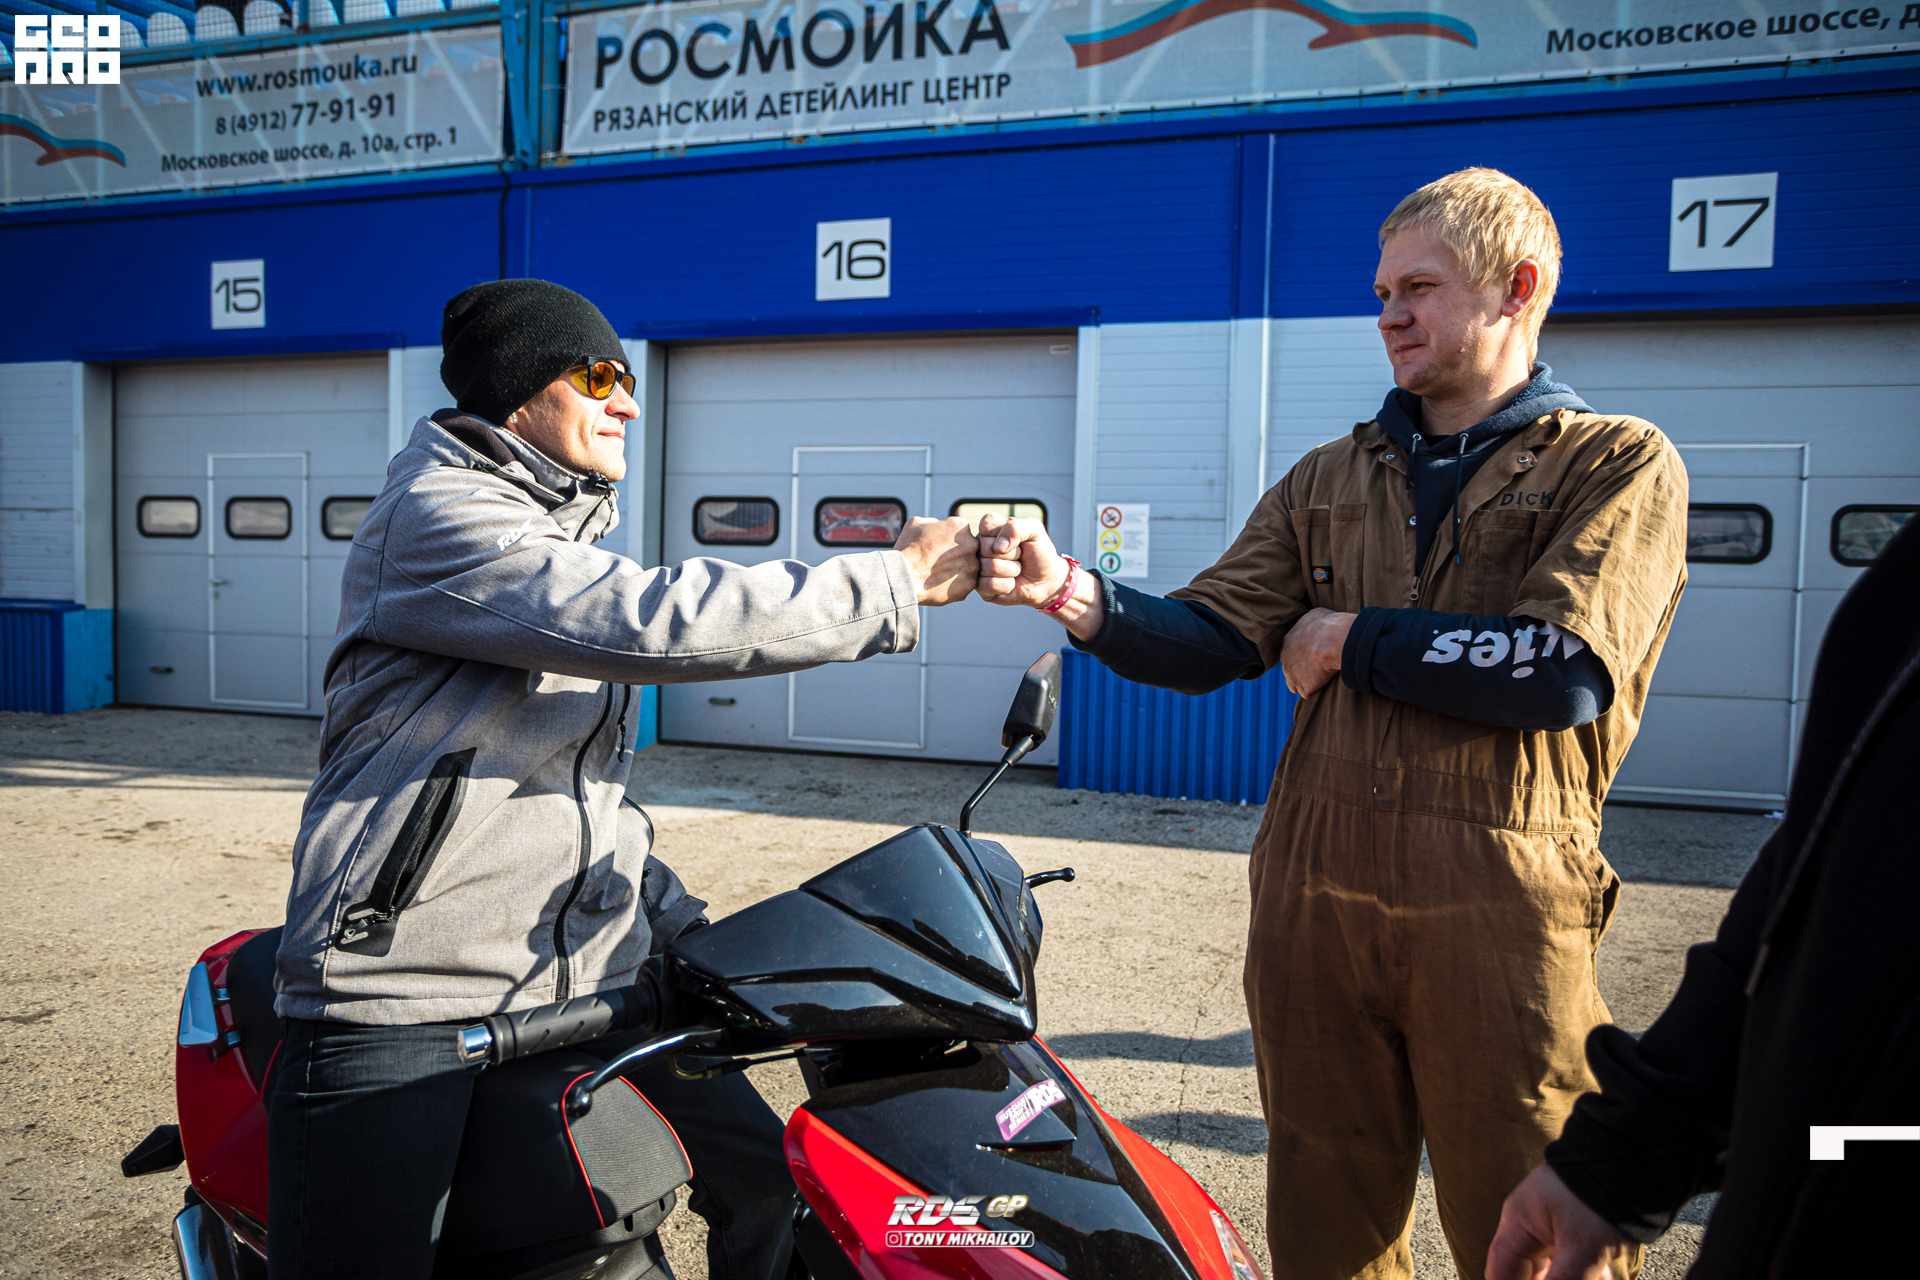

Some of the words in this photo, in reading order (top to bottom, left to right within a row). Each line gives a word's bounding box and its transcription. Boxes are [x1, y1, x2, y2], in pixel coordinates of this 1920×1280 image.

[1546, 18, 1757, 54] Московское
[1766, 7, 1891, 37] шоссе,
[196, 53, 418, 98] www.rosmouka.ru
[215, 116, 227, 135] 8
[231, 109, 287, 136] (4912)
[291, 92, 396, 128] 77-91-91
[593, 90, 748, 133] РЯЗАНСКИЙ
[755, 81, 914, 121] ДЕТЕЙЛИНГ
[923, 72, 1012, 105] ЦЕНТР
[161, 150, 270, 172] Московское
[273, 143, 335, 163] шоссе,
[403, 130, 442, 153] стр.
[447, 125, 457, 145] 1
[1677, 197, 1770, 248] 17
[822, 239, 887, 281] 16
[214, 277, 262, 314] 15
[998, 1095, 1027, 1125] RUSSIAN
[1008, 1110, 1032, 1133] SERIES
